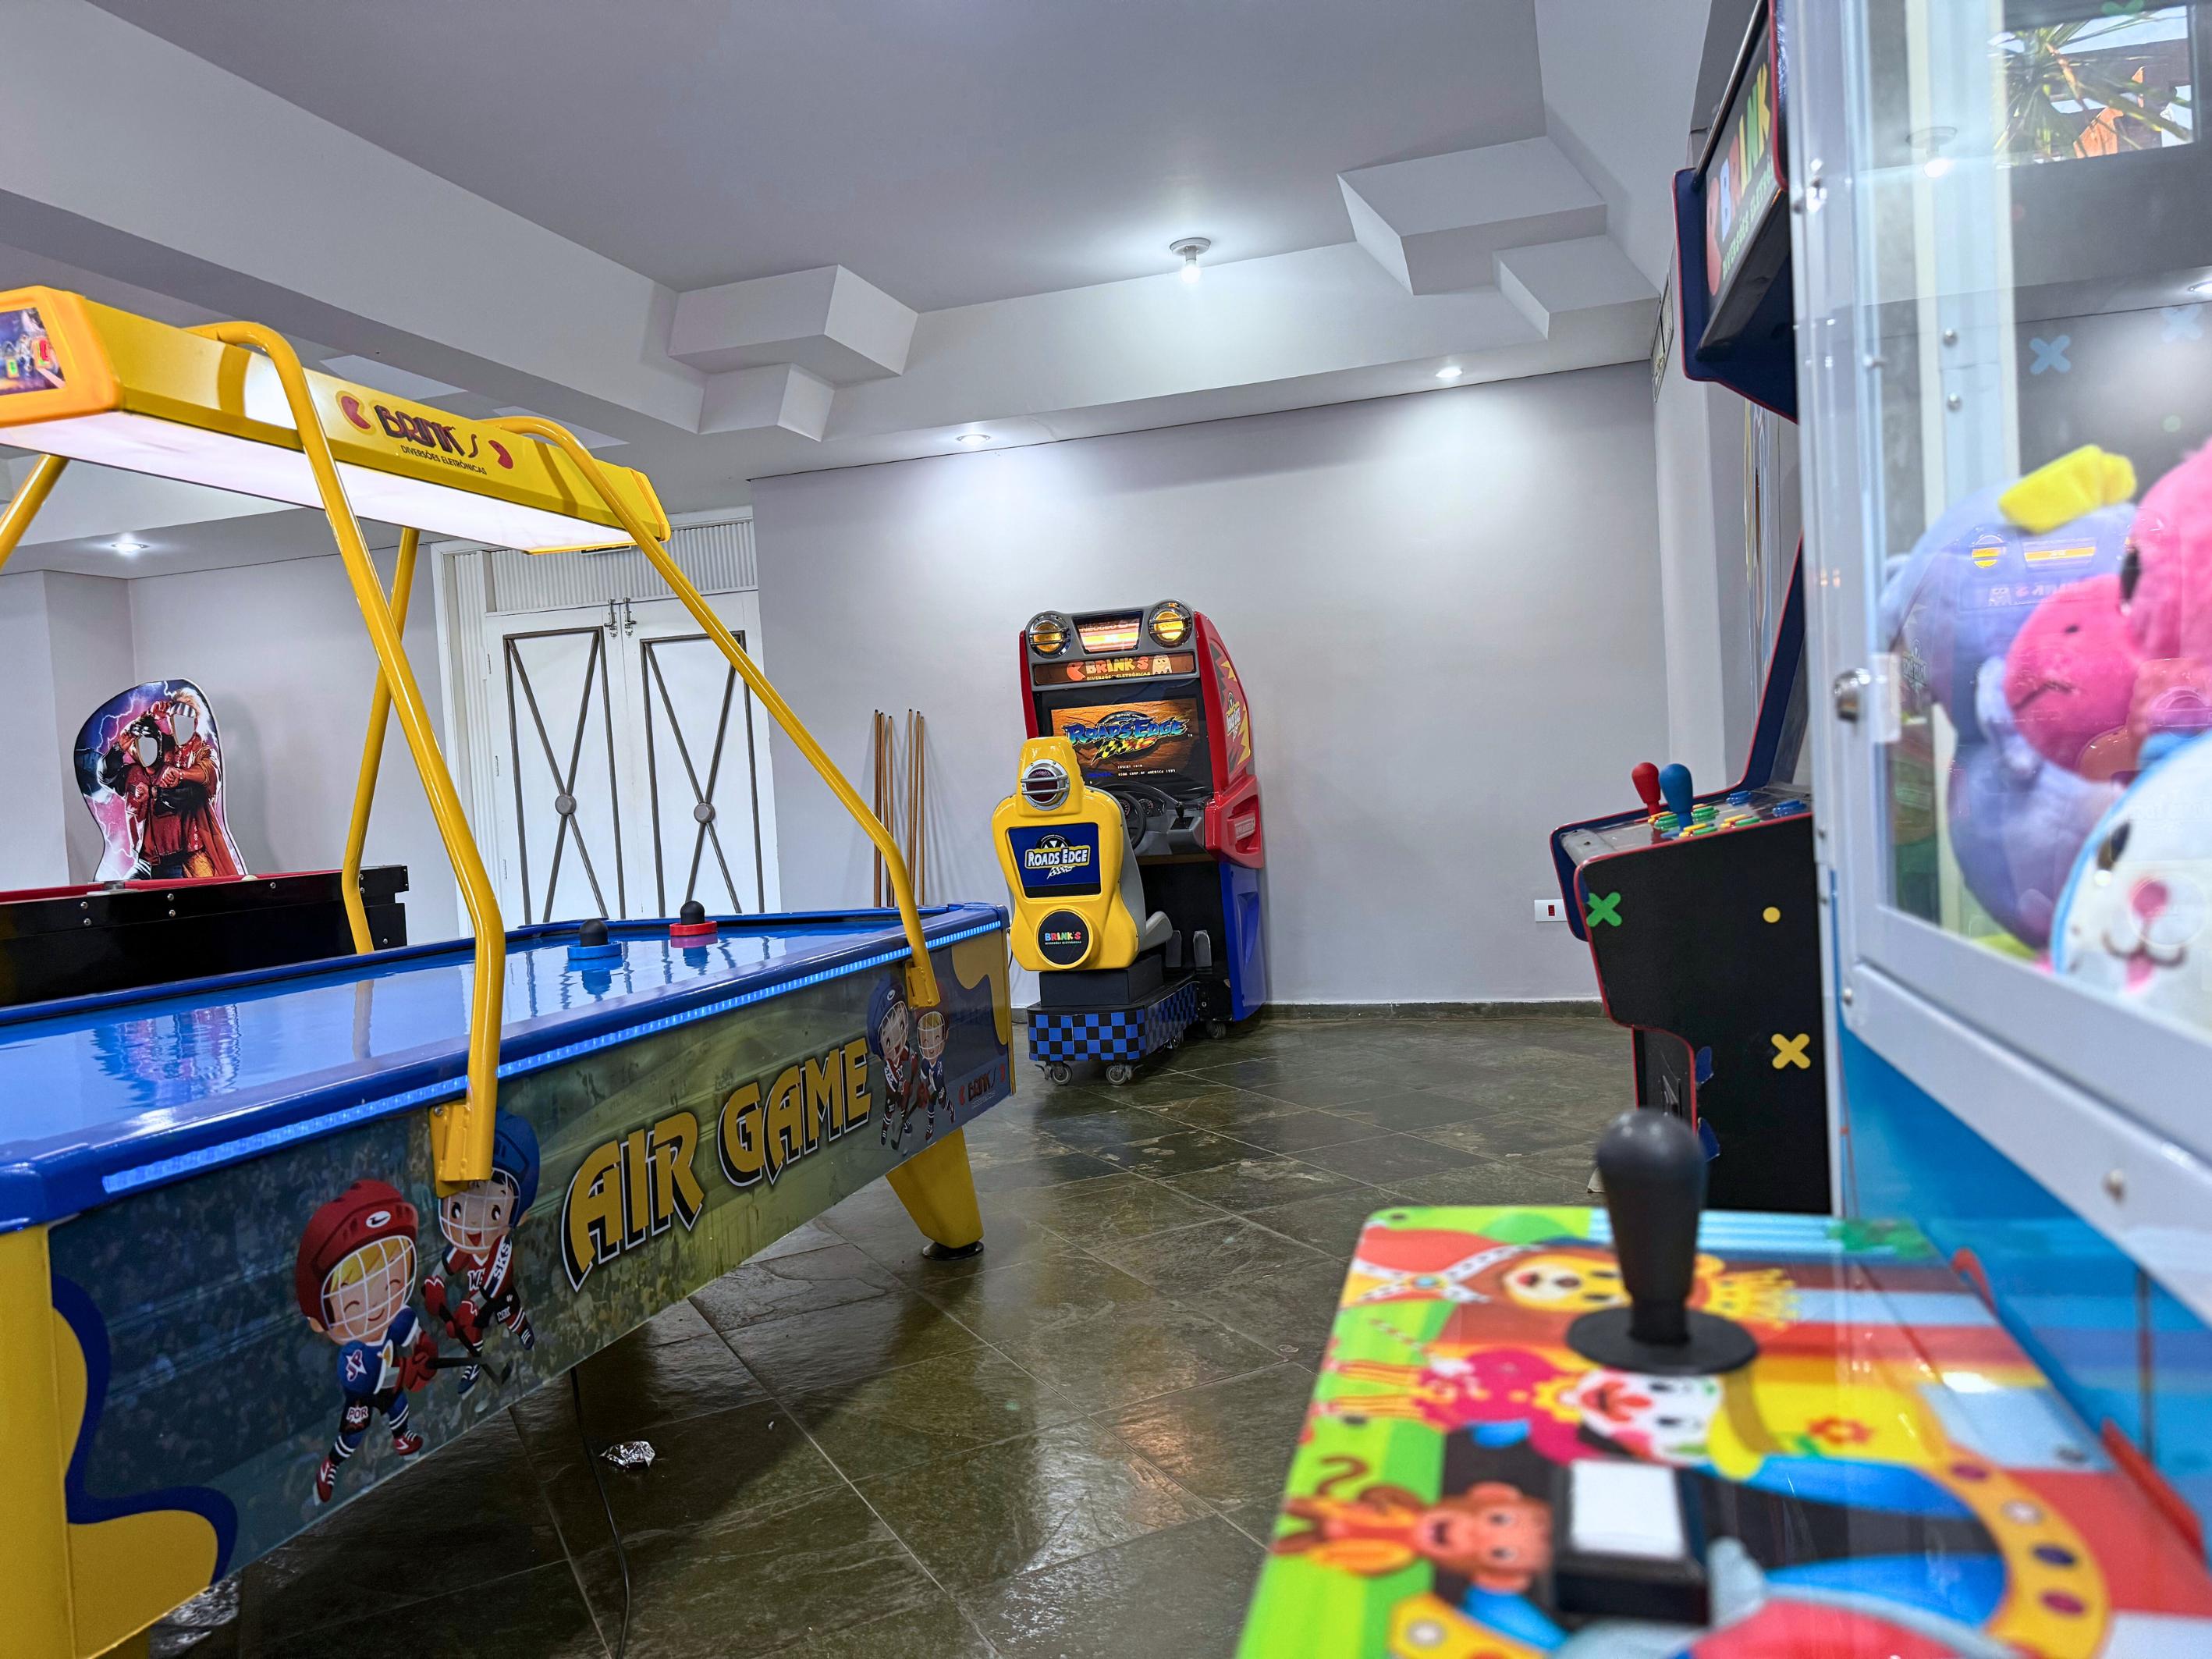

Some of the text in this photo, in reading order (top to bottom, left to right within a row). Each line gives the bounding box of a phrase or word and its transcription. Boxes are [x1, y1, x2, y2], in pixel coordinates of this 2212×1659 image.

[1720, 62, 1770, 243] BRINK
[400, 445, 487, 475] DIVERSÕES ELETRÔNICAS
[1085, 656, 1149, 674] BRINK'S
[1028, 849, 1088, 867] ROADS EDGE
[1044, 931, 1081, 941] BRINK'S
[561, 1037, 872, 1292] AIR GAME
[494, 1244, 510, 1278] SKS
[347, 1406, 368, 1421] POR
